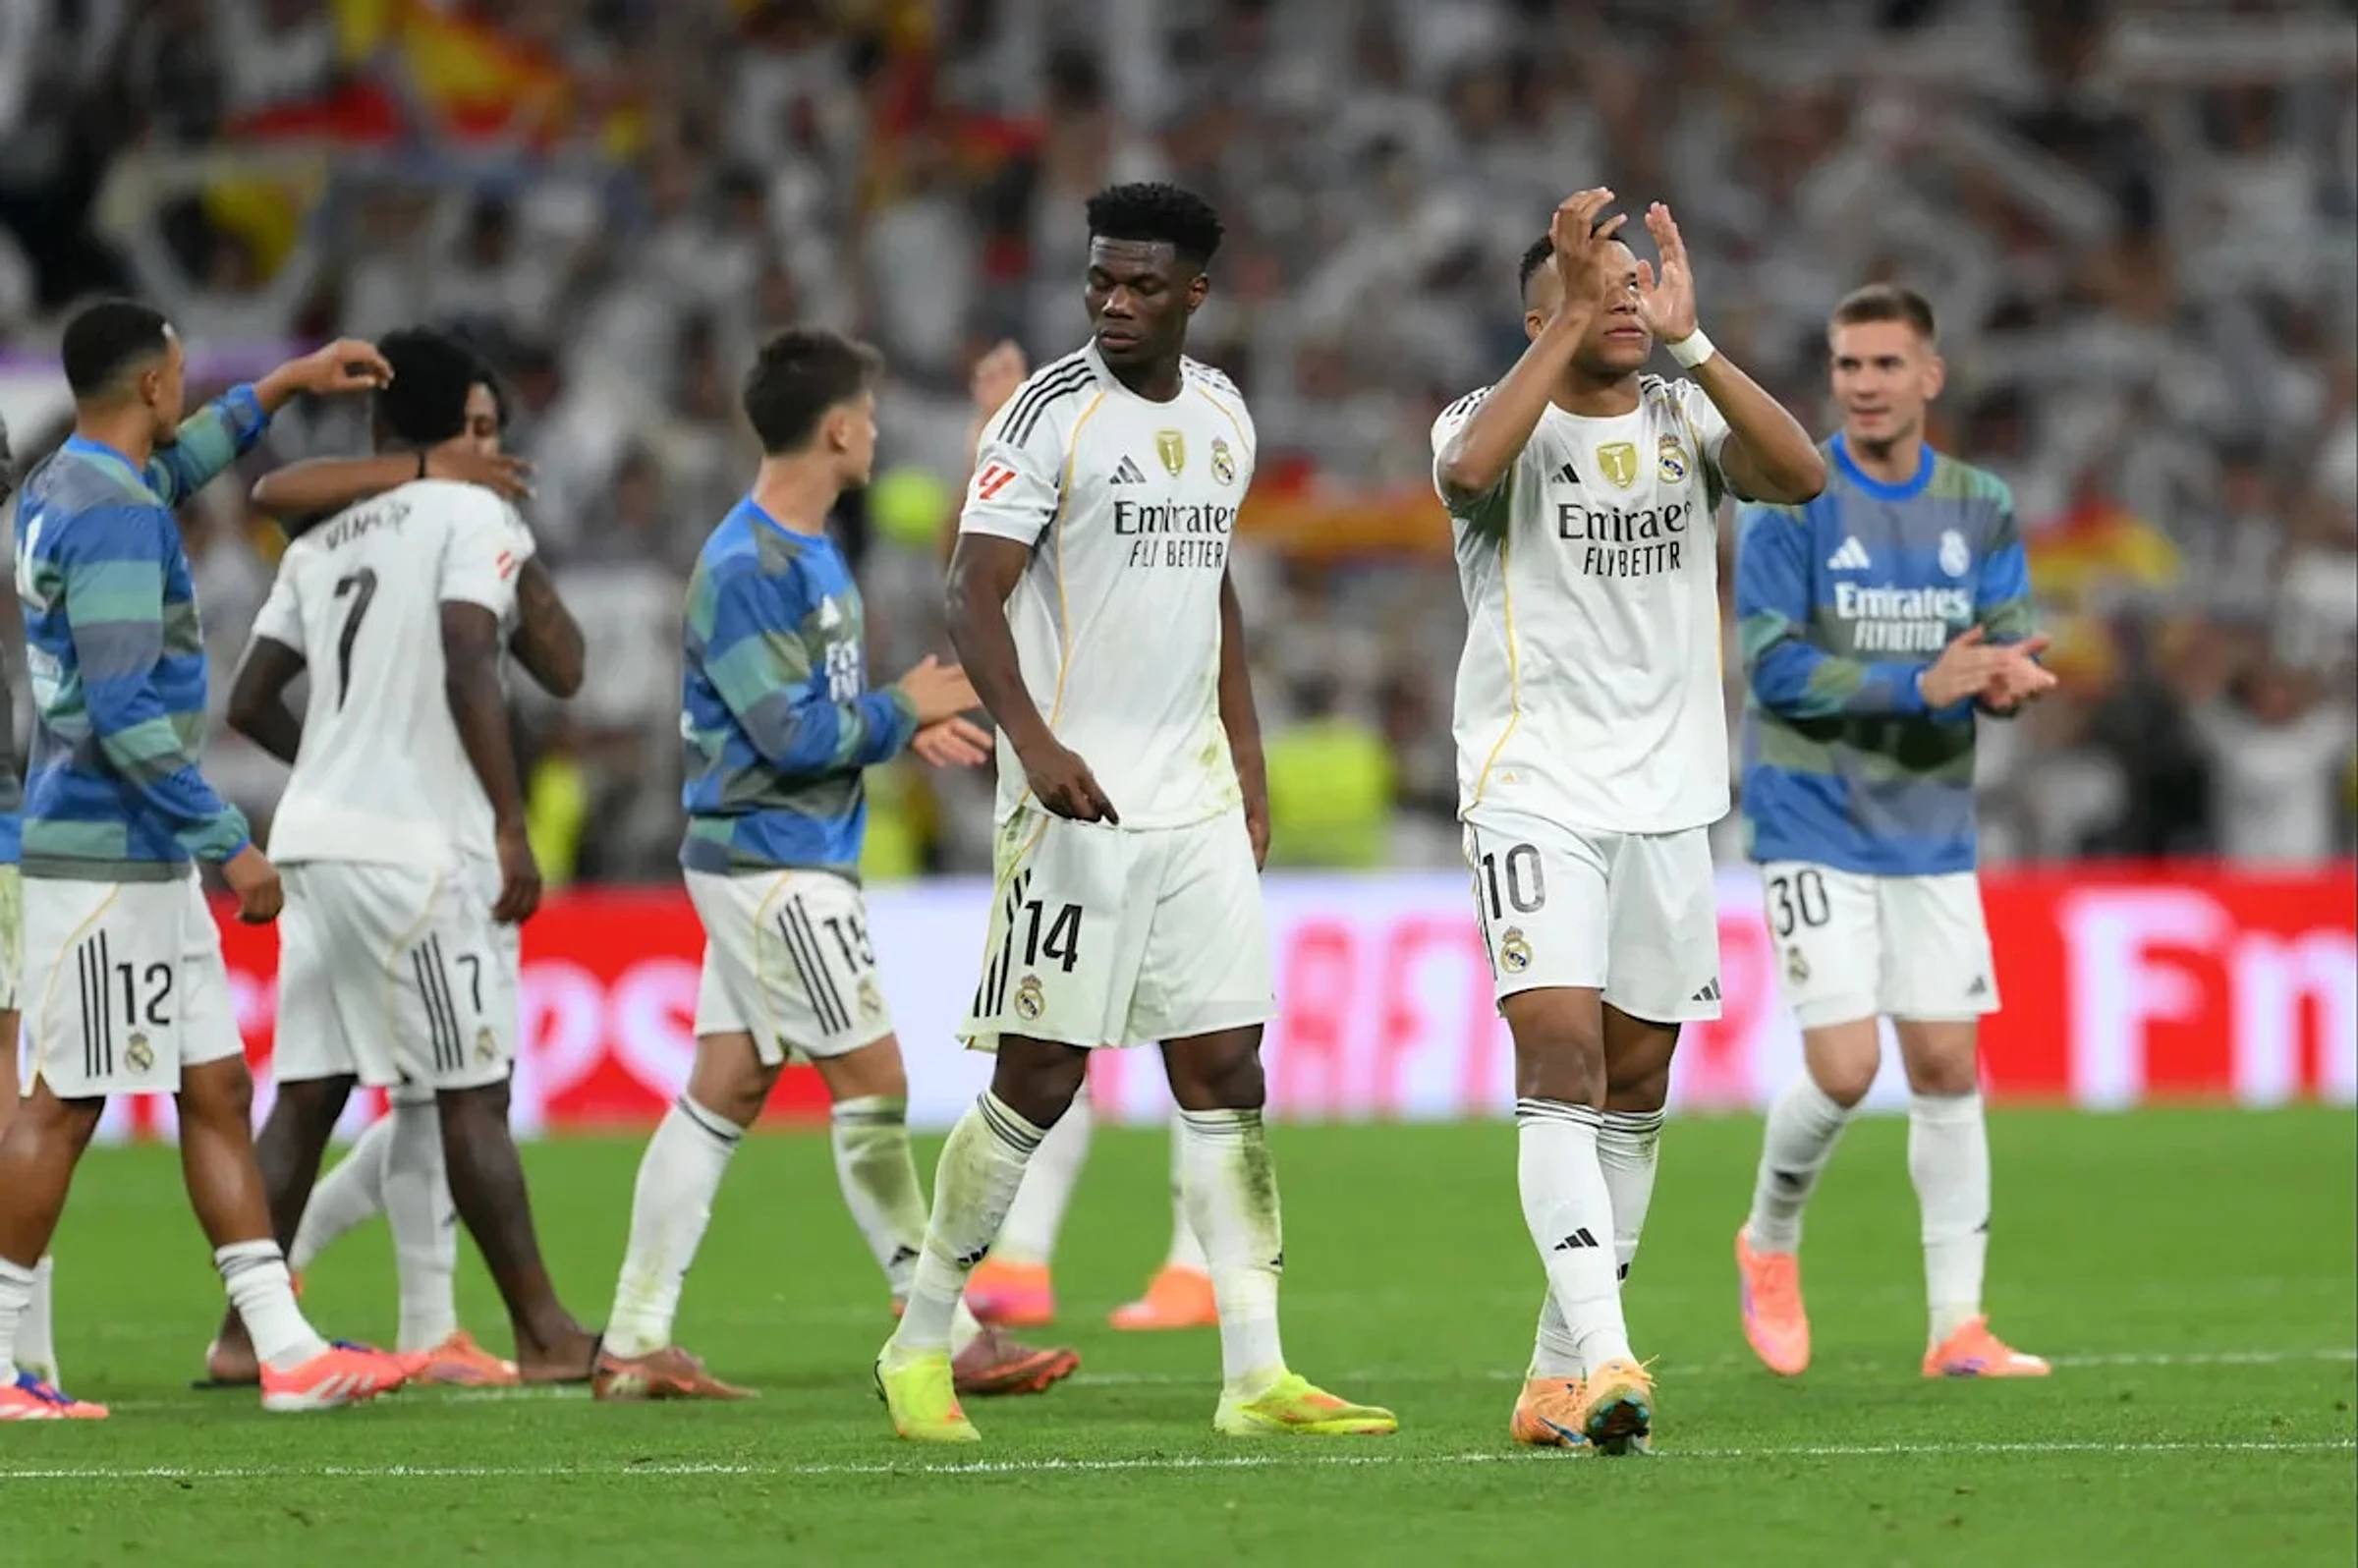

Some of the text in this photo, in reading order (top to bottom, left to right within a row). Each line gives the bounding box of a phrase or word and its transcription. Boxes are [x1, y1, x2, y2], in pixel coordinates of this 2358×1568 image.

[1557, 501, 1692, 542] Emirae
[1166, 539, 1224, 569] BETTER
[1618, 541, 1681, 578] BETTR
[1834, 581, 1971, 620] Emirates
[333, 566, 378, 713] 7
[1482, 843, 1546, 921] 10
[1769, 868, 1830, 938] 30
[1024, 900, 1083, 973] 14
[116, 962, 172, 1027] 12
[456, 952, 481, 1014] 7
